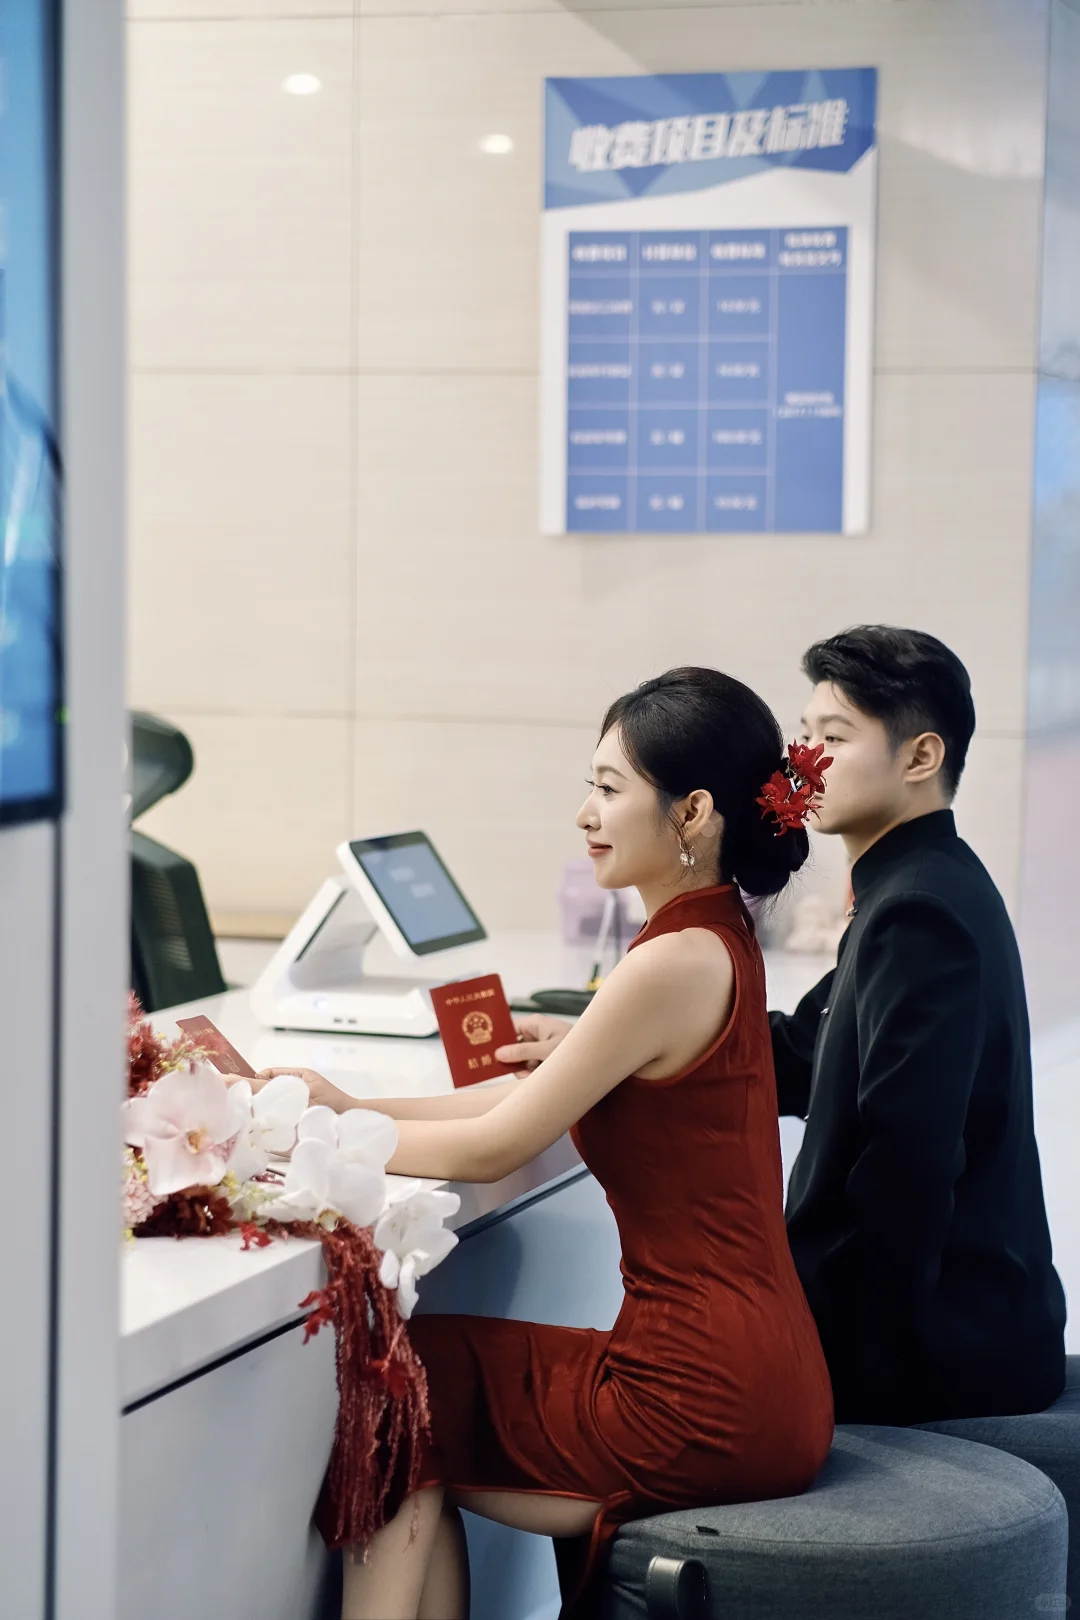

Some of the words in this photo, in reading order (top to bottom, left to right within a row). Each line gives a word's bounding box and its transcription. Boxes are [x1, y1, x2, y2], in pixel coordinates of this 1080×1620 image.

[568, 97, 849, 172] 收费项目及标准
[468, 1054, 492, 1070] 结婚
